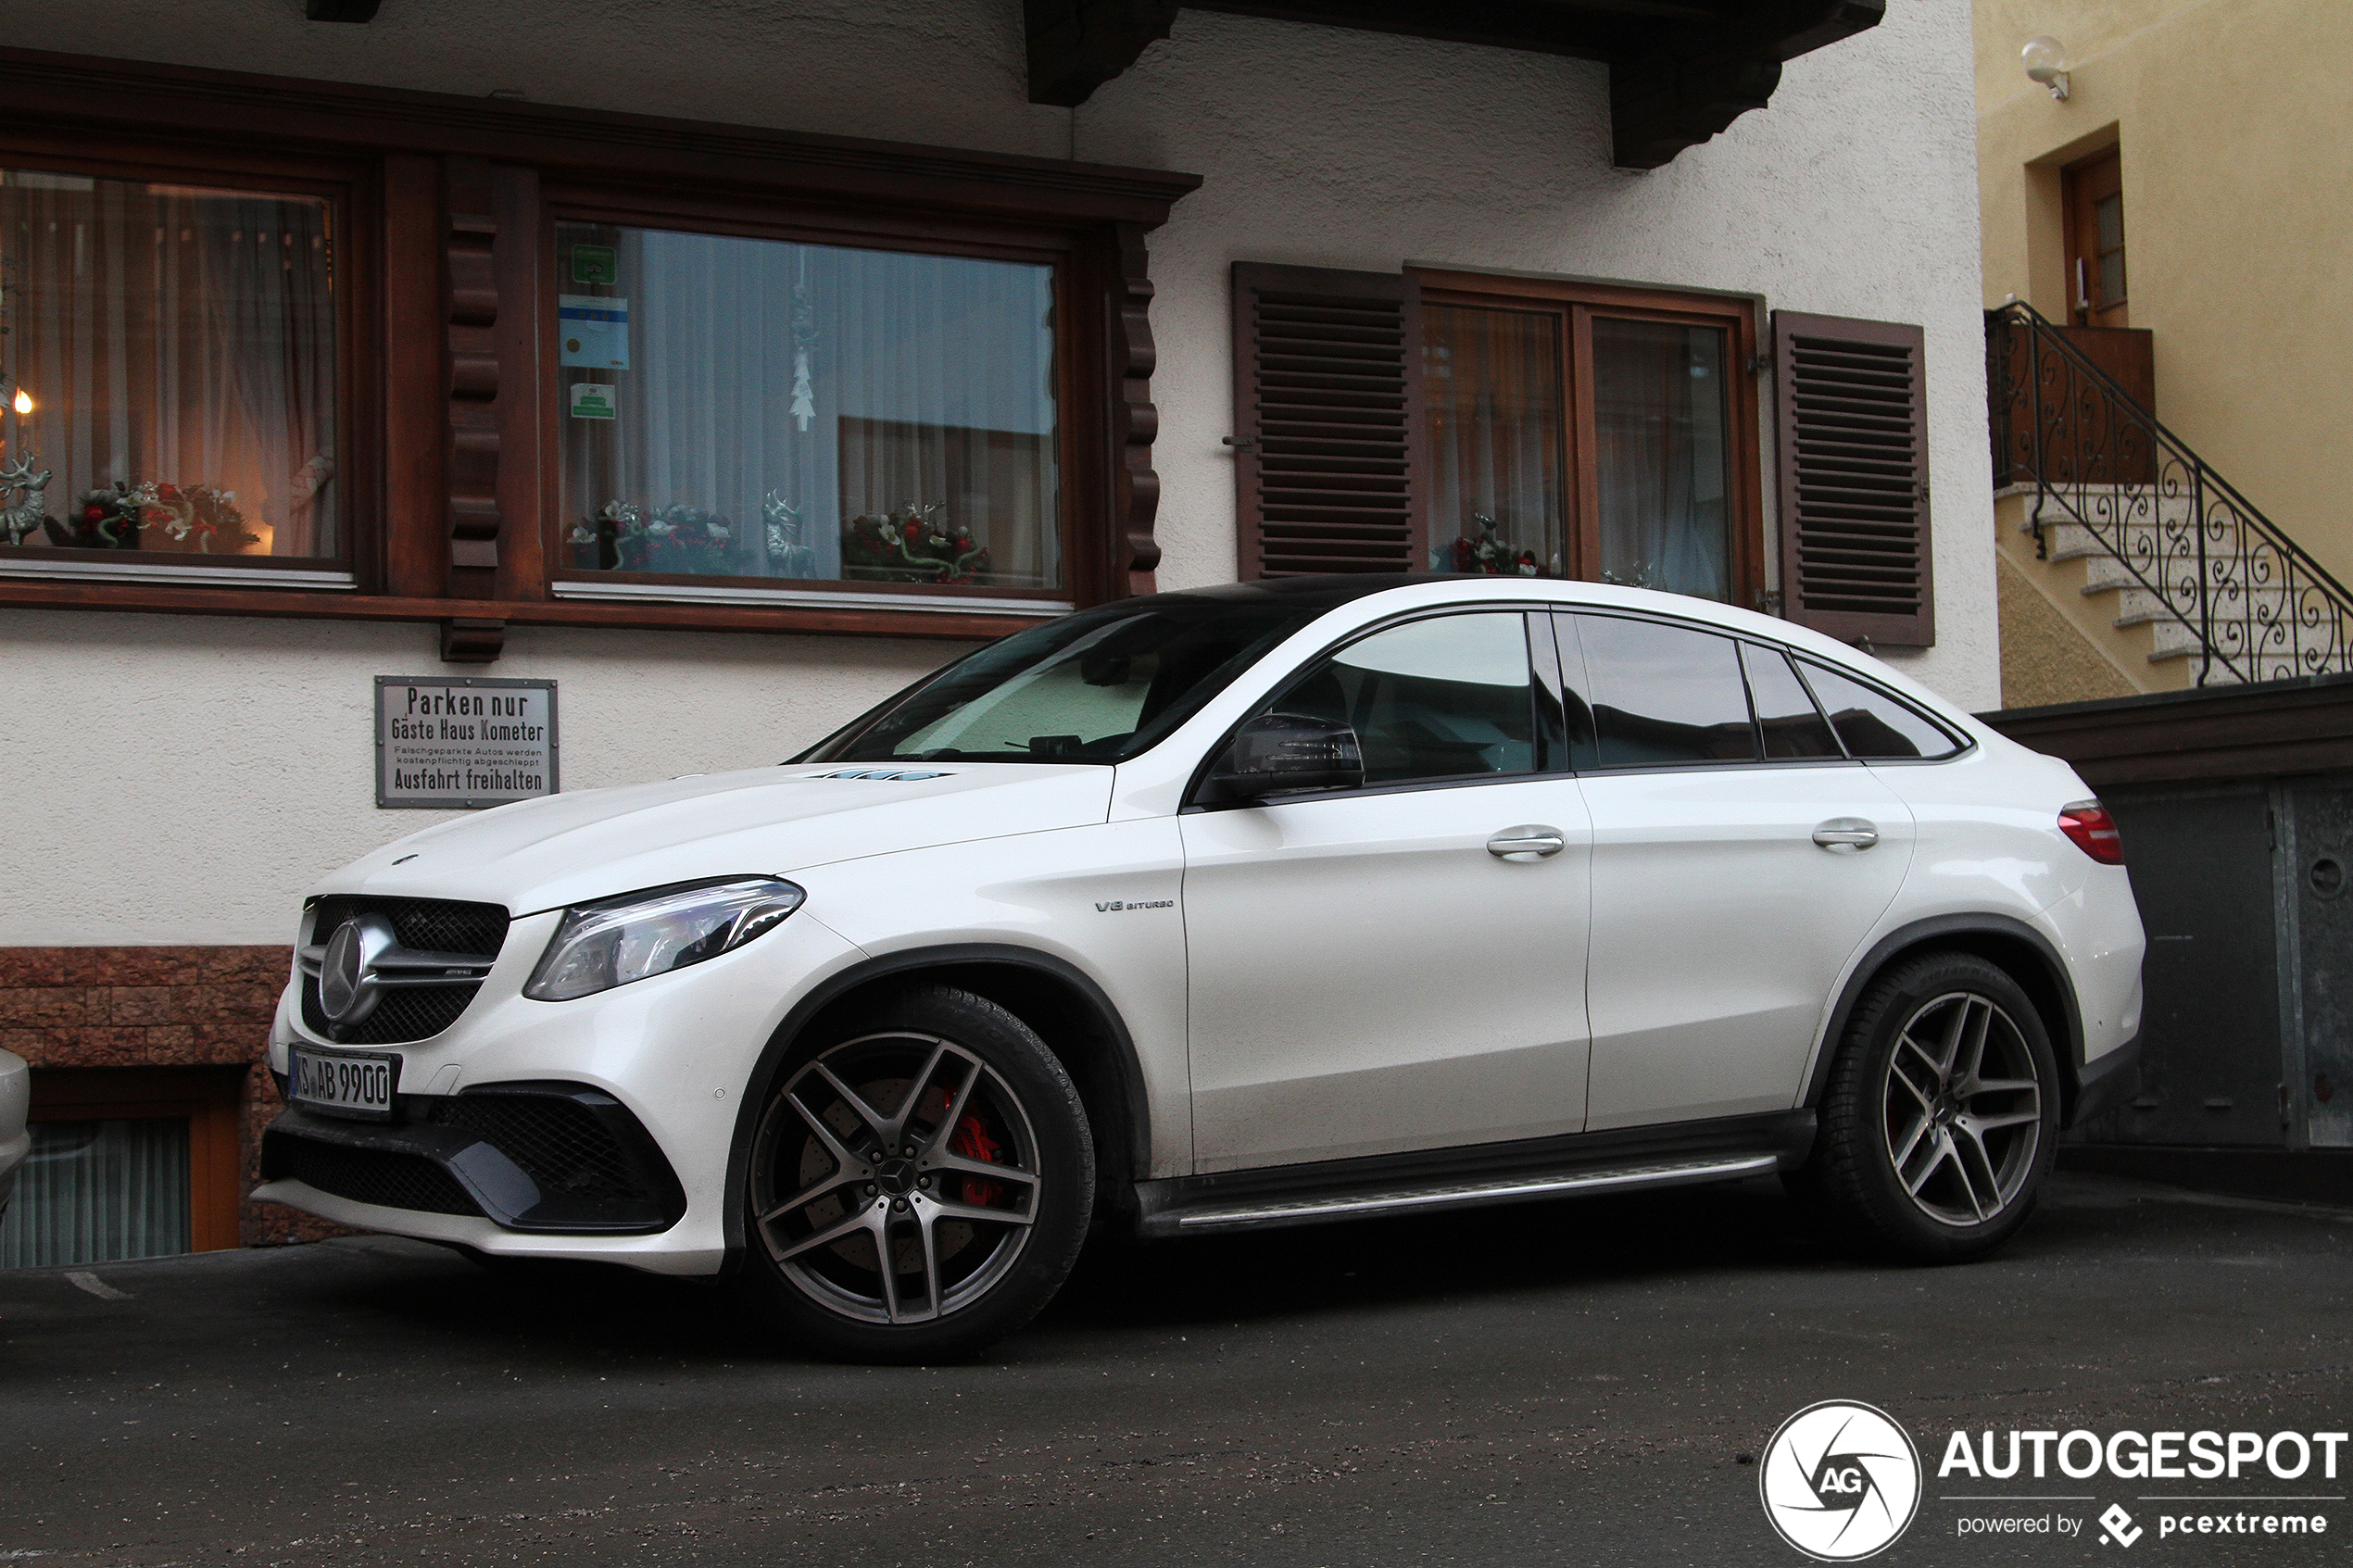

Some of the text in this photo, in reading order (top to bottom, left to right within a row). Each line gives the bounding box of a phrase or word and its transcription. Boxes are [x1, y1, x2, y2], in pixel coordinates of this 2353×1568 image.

[408, 686, 528, 717] Parken nur
[391, 717, 544, 741] Gäste Haus Kometer
[394, 746, 542, 757] Falschgeparkte Autos werden
[396, 757, 539, 767] kostenpflichtig abgeschleppt
[395, 768, 542, 790] Ausfahrt freihalten
[1095, 900, 1174, 912] V8 BITURBO
[318, 1059, 336, 1100] AB
[339, 1062, 389, 1105] 9900
